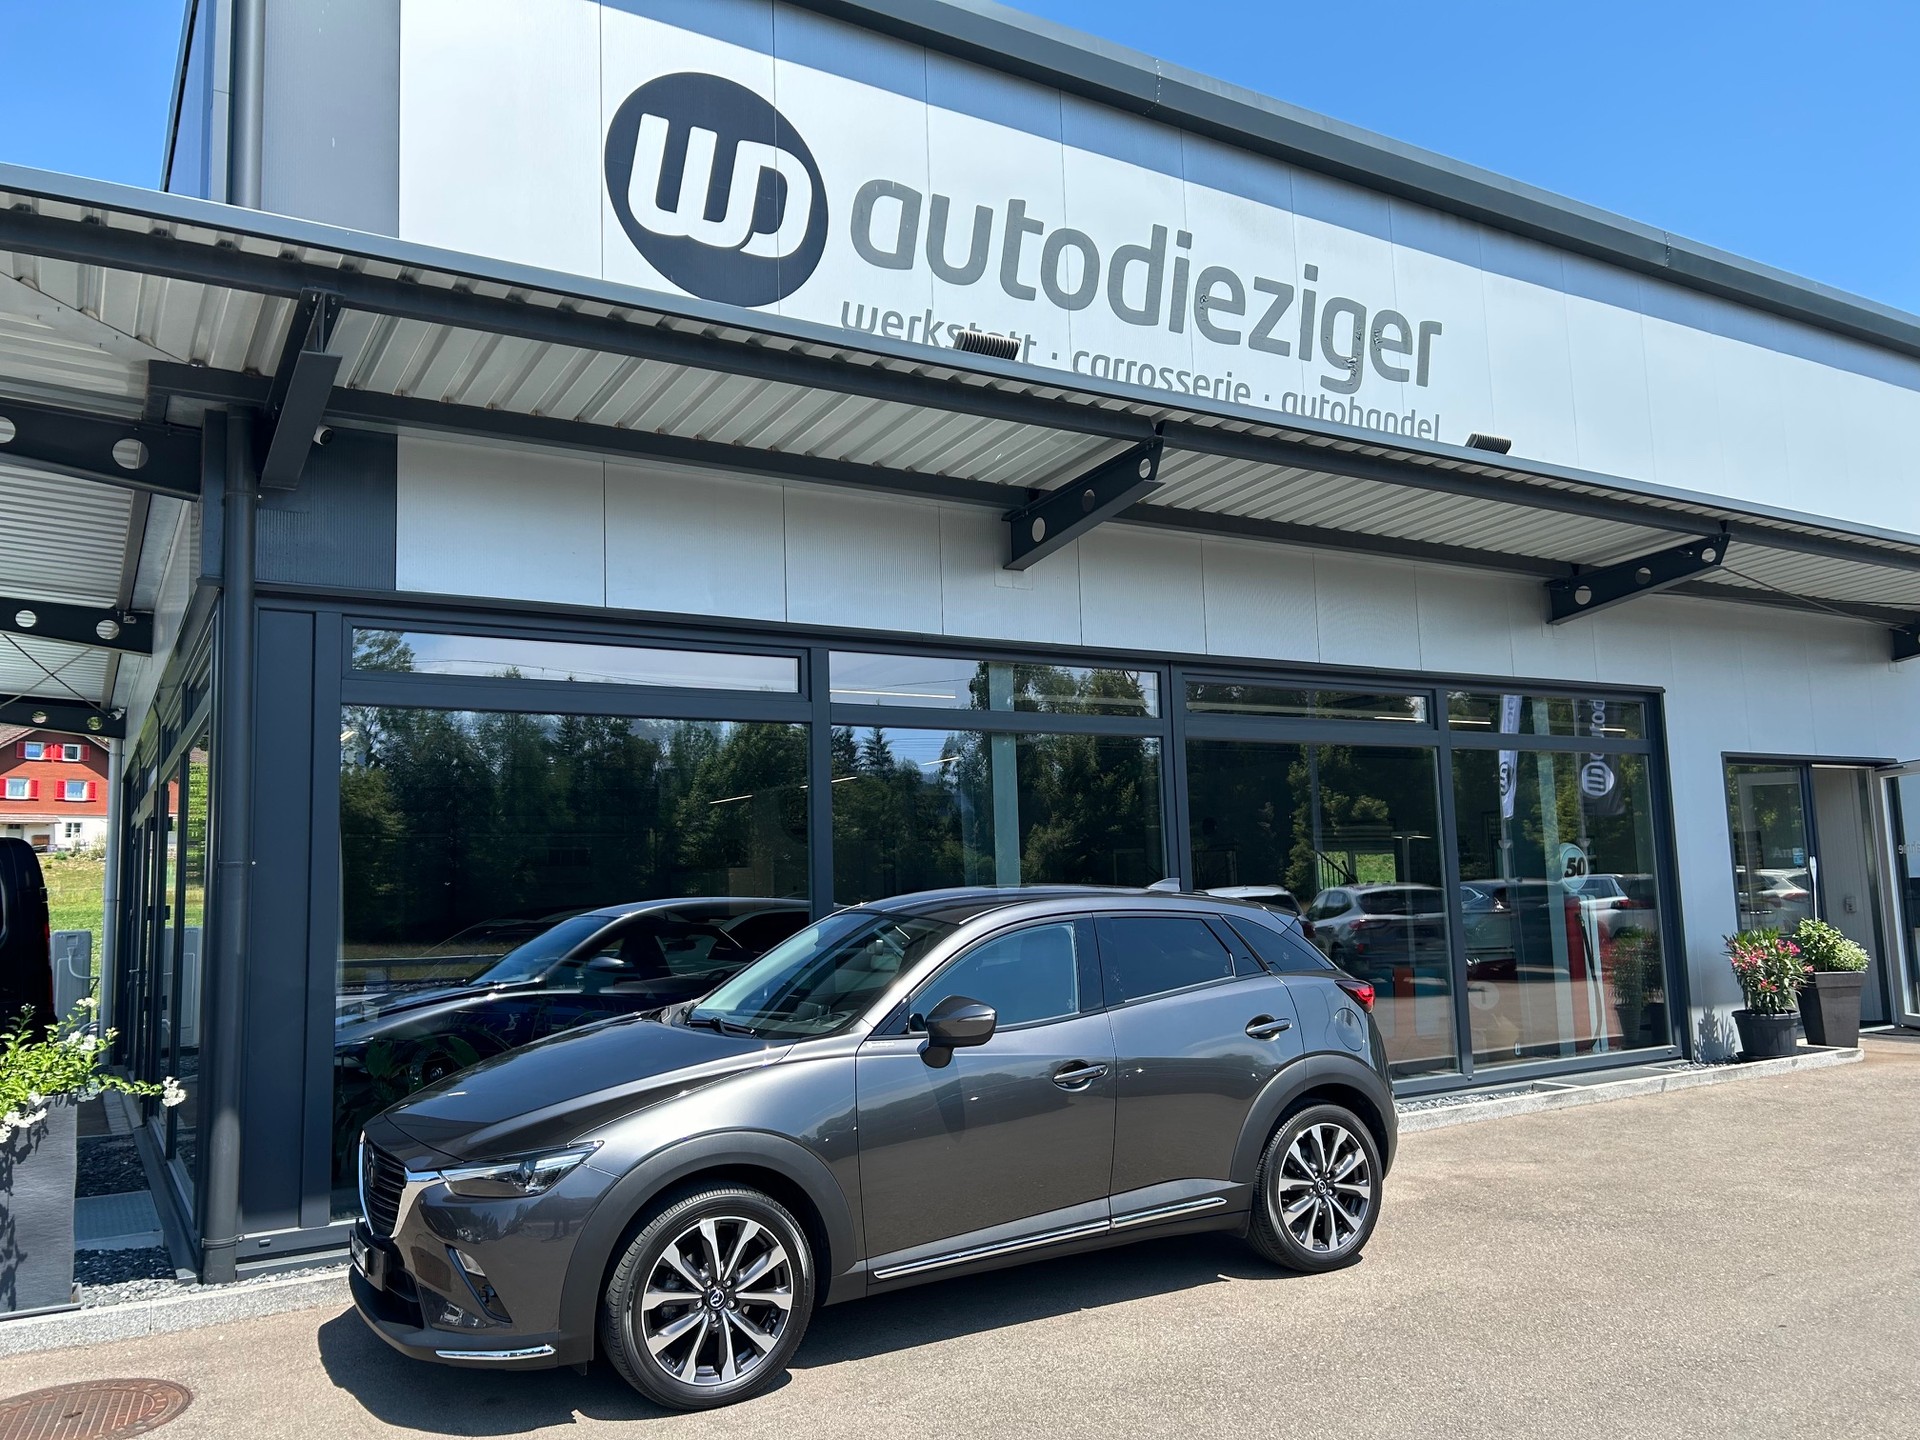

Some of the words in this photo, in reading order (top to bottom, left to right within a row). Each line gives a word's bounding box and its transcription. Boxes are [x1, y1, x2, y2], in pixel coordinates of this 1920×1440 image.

[851, 179, 1442, 394] autodieziger
[1073, 351, 1250, 405] carrosserie
[1282, 392, 1440, 441] autohandel
[1564, 857, 1586, 877] 50
